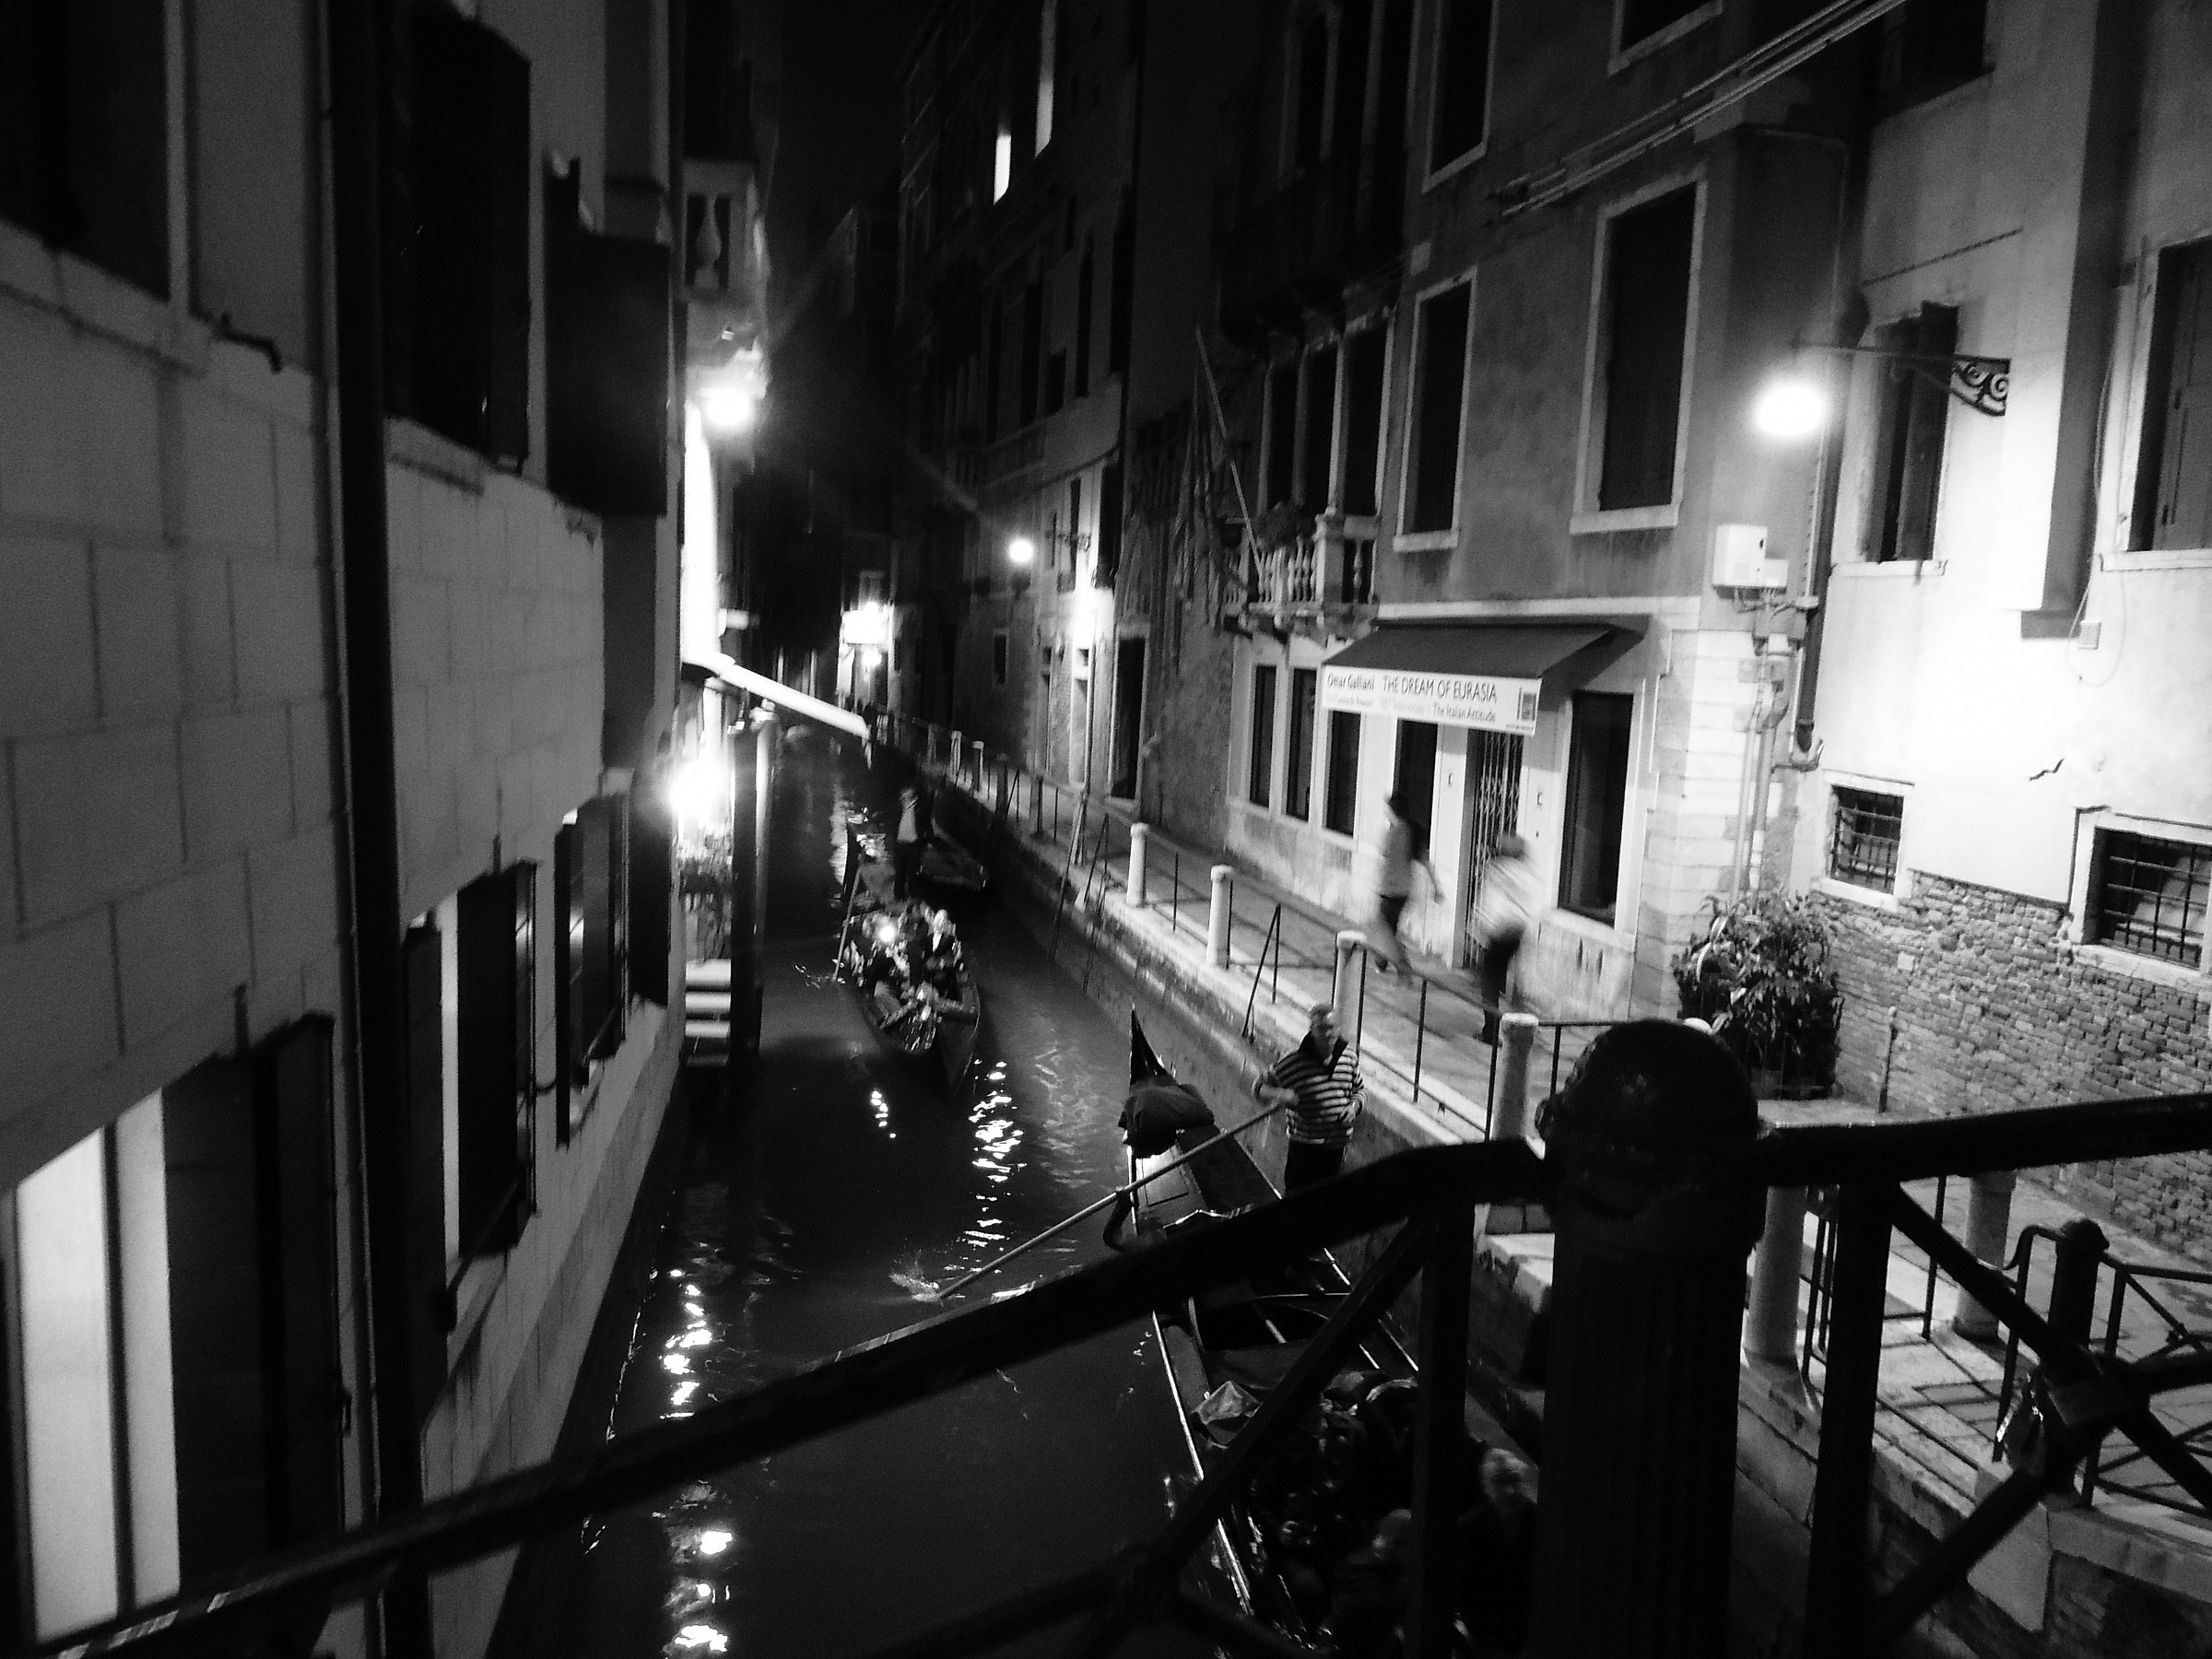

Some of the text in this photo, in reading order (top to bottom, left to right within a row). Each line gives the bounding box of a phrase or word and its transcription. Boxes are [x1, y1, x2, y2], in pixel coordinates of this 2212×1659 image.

[1382, 675, 1399, 693] THE
[1402, 677, 1435, 697] DREAM
[1437, 679, 1452, 699] OF
[1453, 680, 1498, 704] EURASIA
